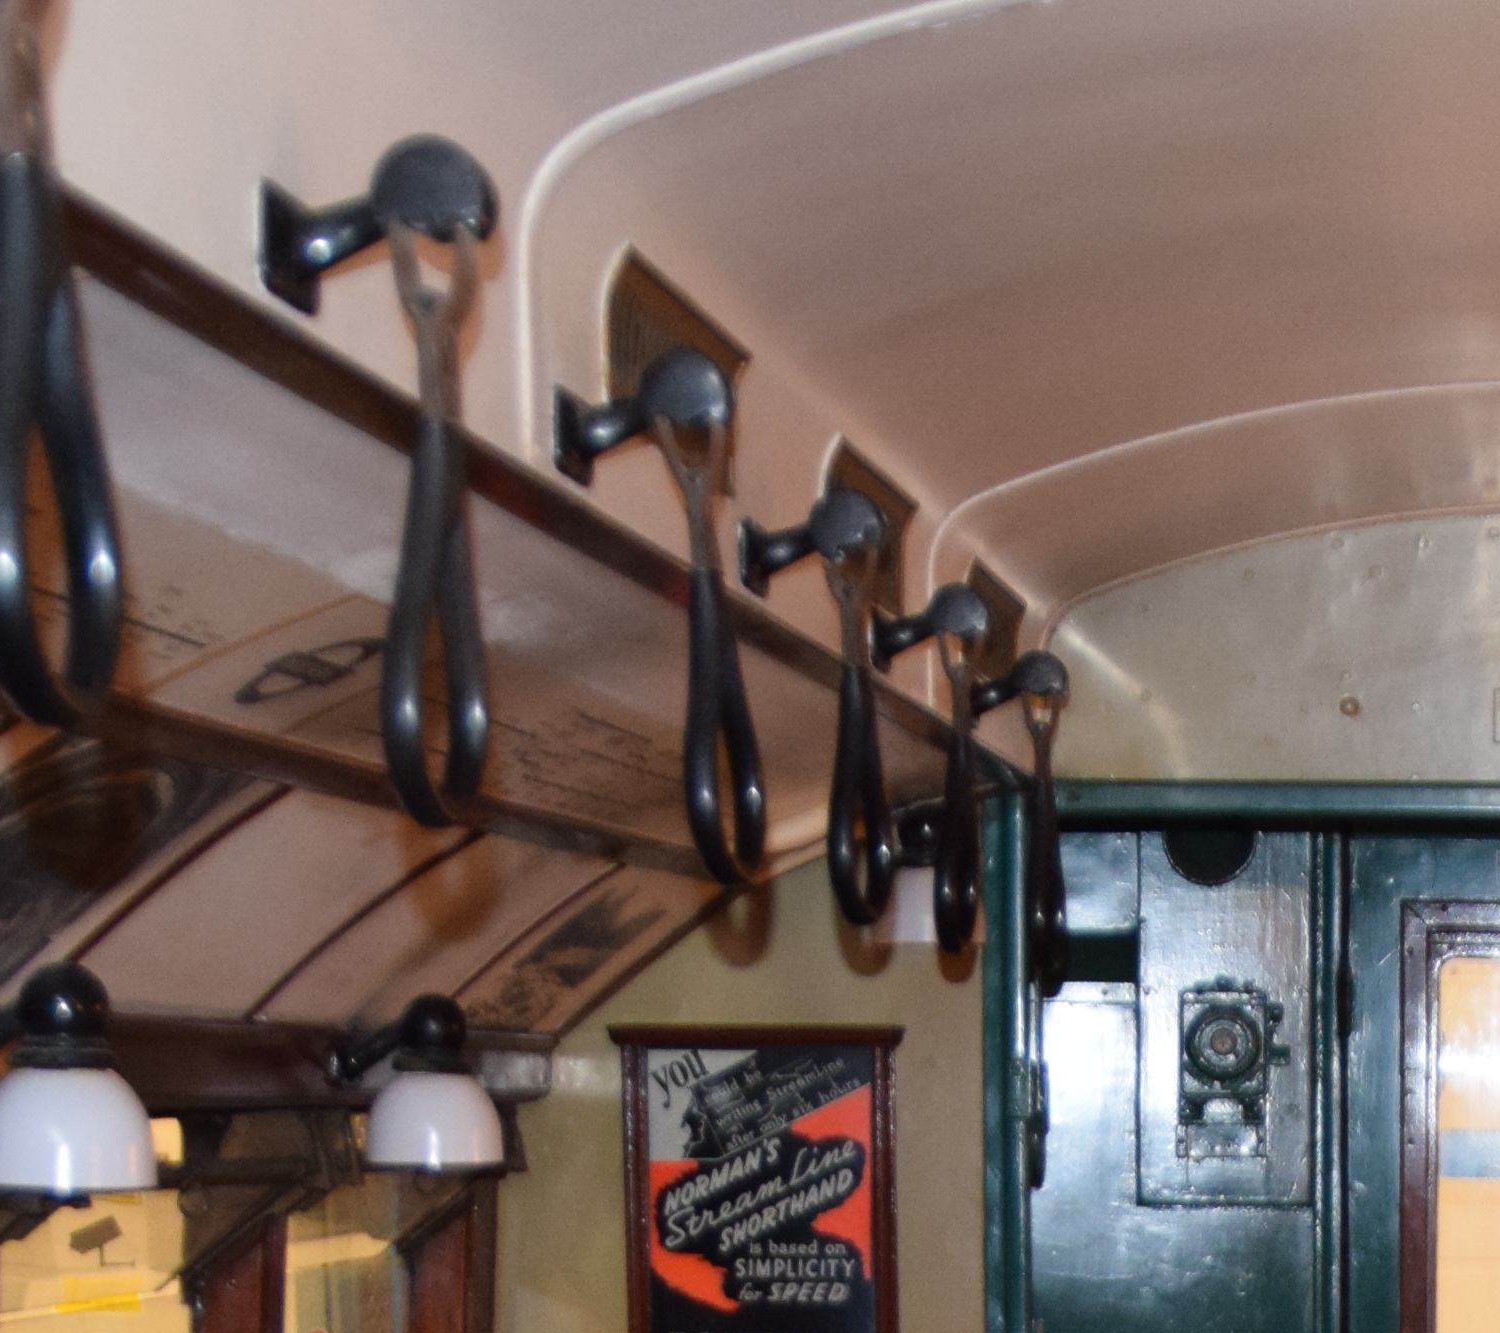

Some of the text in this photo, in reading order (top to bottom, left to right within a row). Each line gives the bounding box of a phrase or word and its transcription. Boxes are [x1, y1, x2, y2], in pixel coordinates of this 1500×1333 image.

[651, 1049, 709, 1108] you
[745, 1068, 763, 1084] be
[715, 1098, 763, 1128] writing
[725, 1131, 755, 1151] after
[759, 1113, 788, 1135] only
[792, 1099, 815, 1119] six
[663, 1136, 782, 1216] NORMAN'S
[718, 1168, 855, 1252] SHORTHAND
[750, 1239, 847, 1255] is based on
[735, 1258, 857, 1278] SIMPLICITY
[738, 1282, 851, 1303] for SPEED
